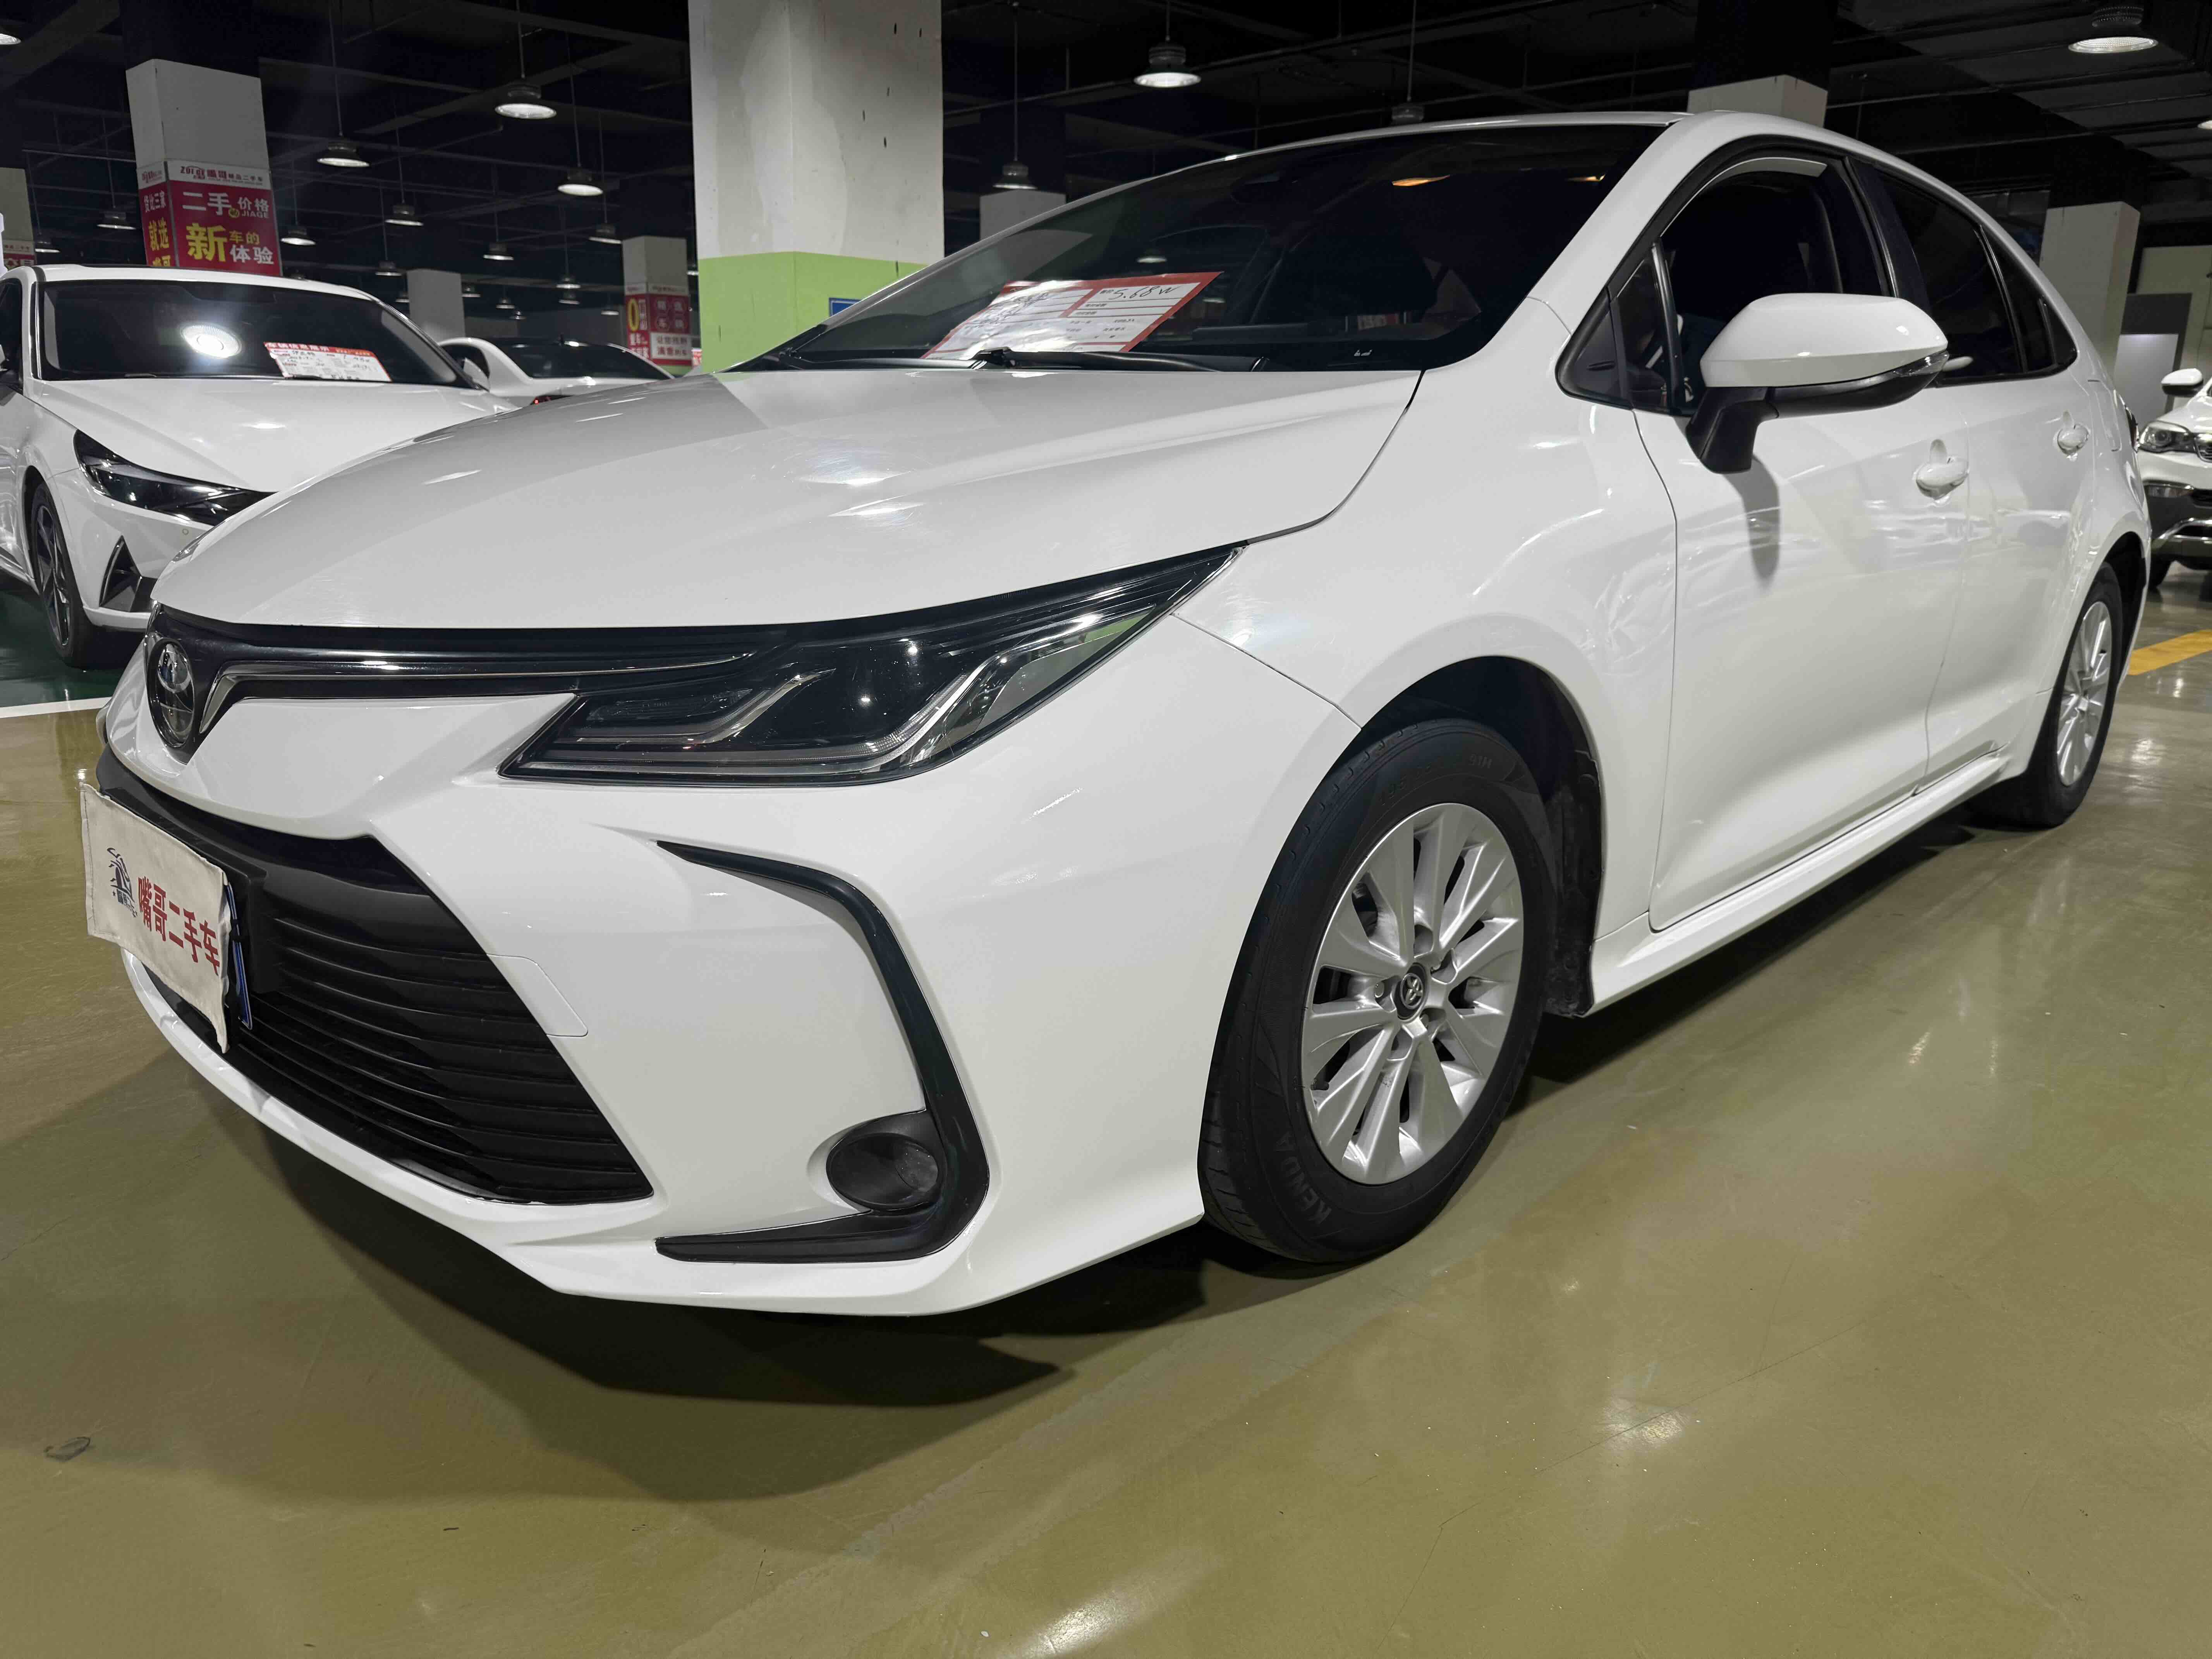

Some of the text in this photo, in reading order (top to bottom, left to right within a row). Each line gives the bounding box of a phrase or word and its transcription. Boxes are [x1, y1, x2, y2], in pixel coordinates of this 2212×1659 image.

[182, 191, 232, 216] 二手
[238, 197, 270, 212] 价格
[185, 222, 228, 262] 新
[229, 230, 260, 245] 车的
[230, 244, 274, 265] 体验
[137, 876, 220, 976] 嘴哥二手车
[1273, 1130, 1333, 1225] KENDA
